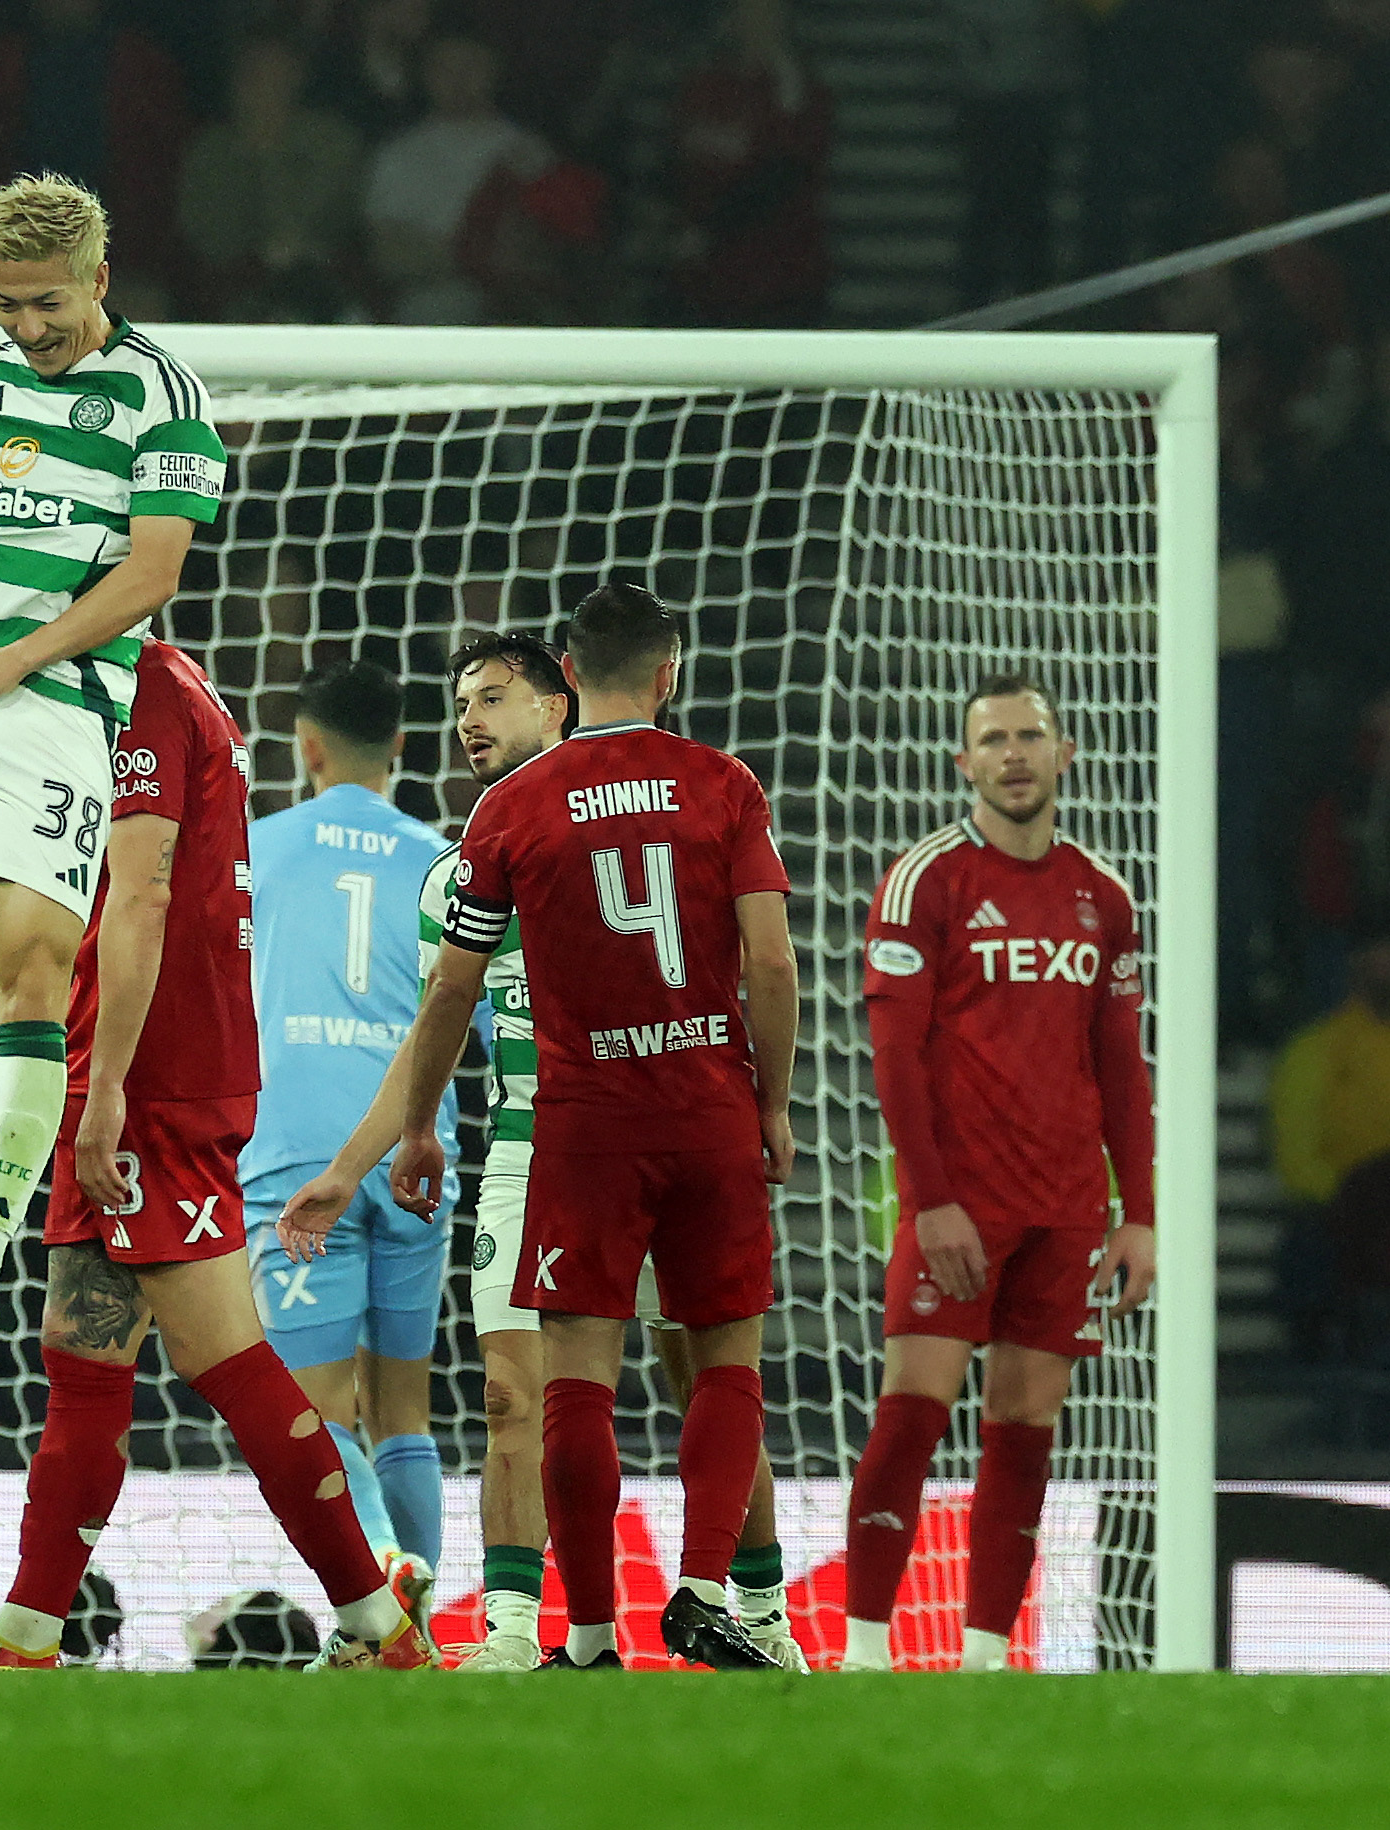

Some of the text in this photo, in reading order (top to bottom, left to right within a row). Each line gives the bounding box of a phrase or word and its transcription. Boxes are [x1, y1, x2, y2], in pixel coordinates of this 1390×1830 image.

[159, 454, 208, 475] CELTIC FC
[159, 473, 221, 496] FOUNDATION
[32, 780, 102, 858] 38
[567, 779, 680, 823] SHINNIE
[316, 822, 398, 857] MITOV
[334, 871, 375, 995] 1
[590, 842, 687, 989] 4
[969, 938, 1101, 987] TEXO
[628, 1014, 729, 1057] WASTE
